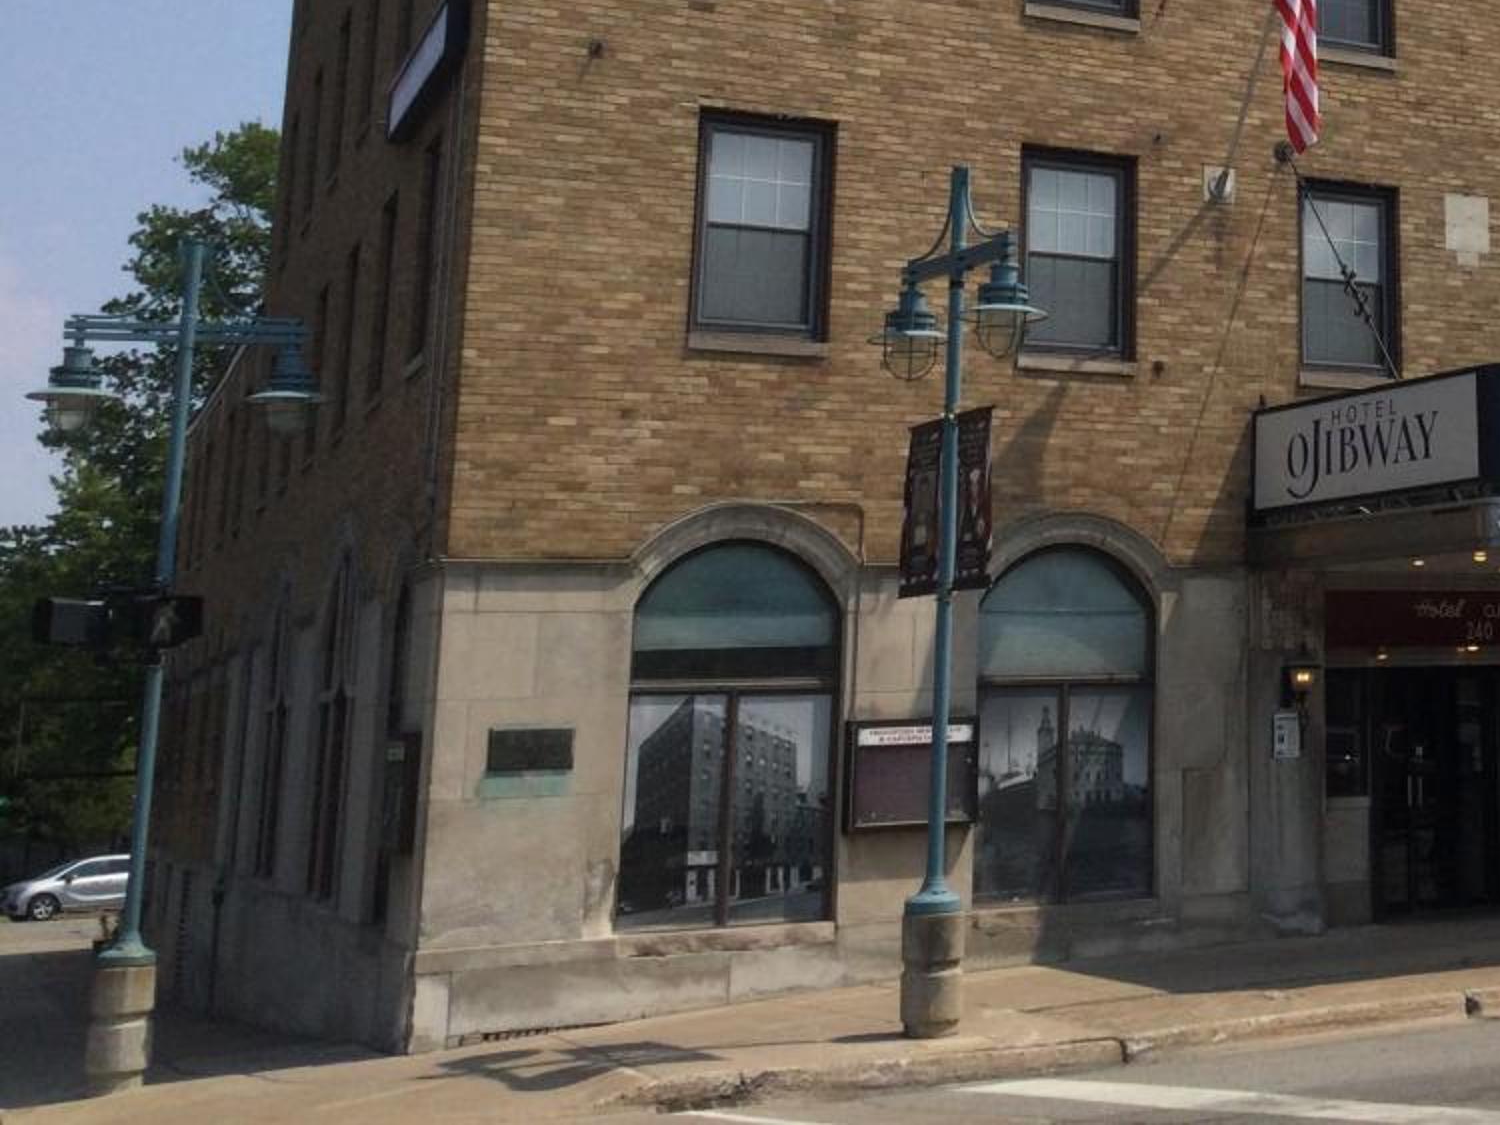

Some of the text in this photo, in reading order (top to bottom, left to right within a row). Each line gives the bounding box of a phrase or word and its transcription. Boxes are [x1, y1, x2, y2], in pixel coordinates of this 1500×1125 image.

[1331, 399, 1397, 425] HOTEL
[1287, 411, 1439, 499] OJIBWAY
[1414, 599, 1466, 618] Hotel
